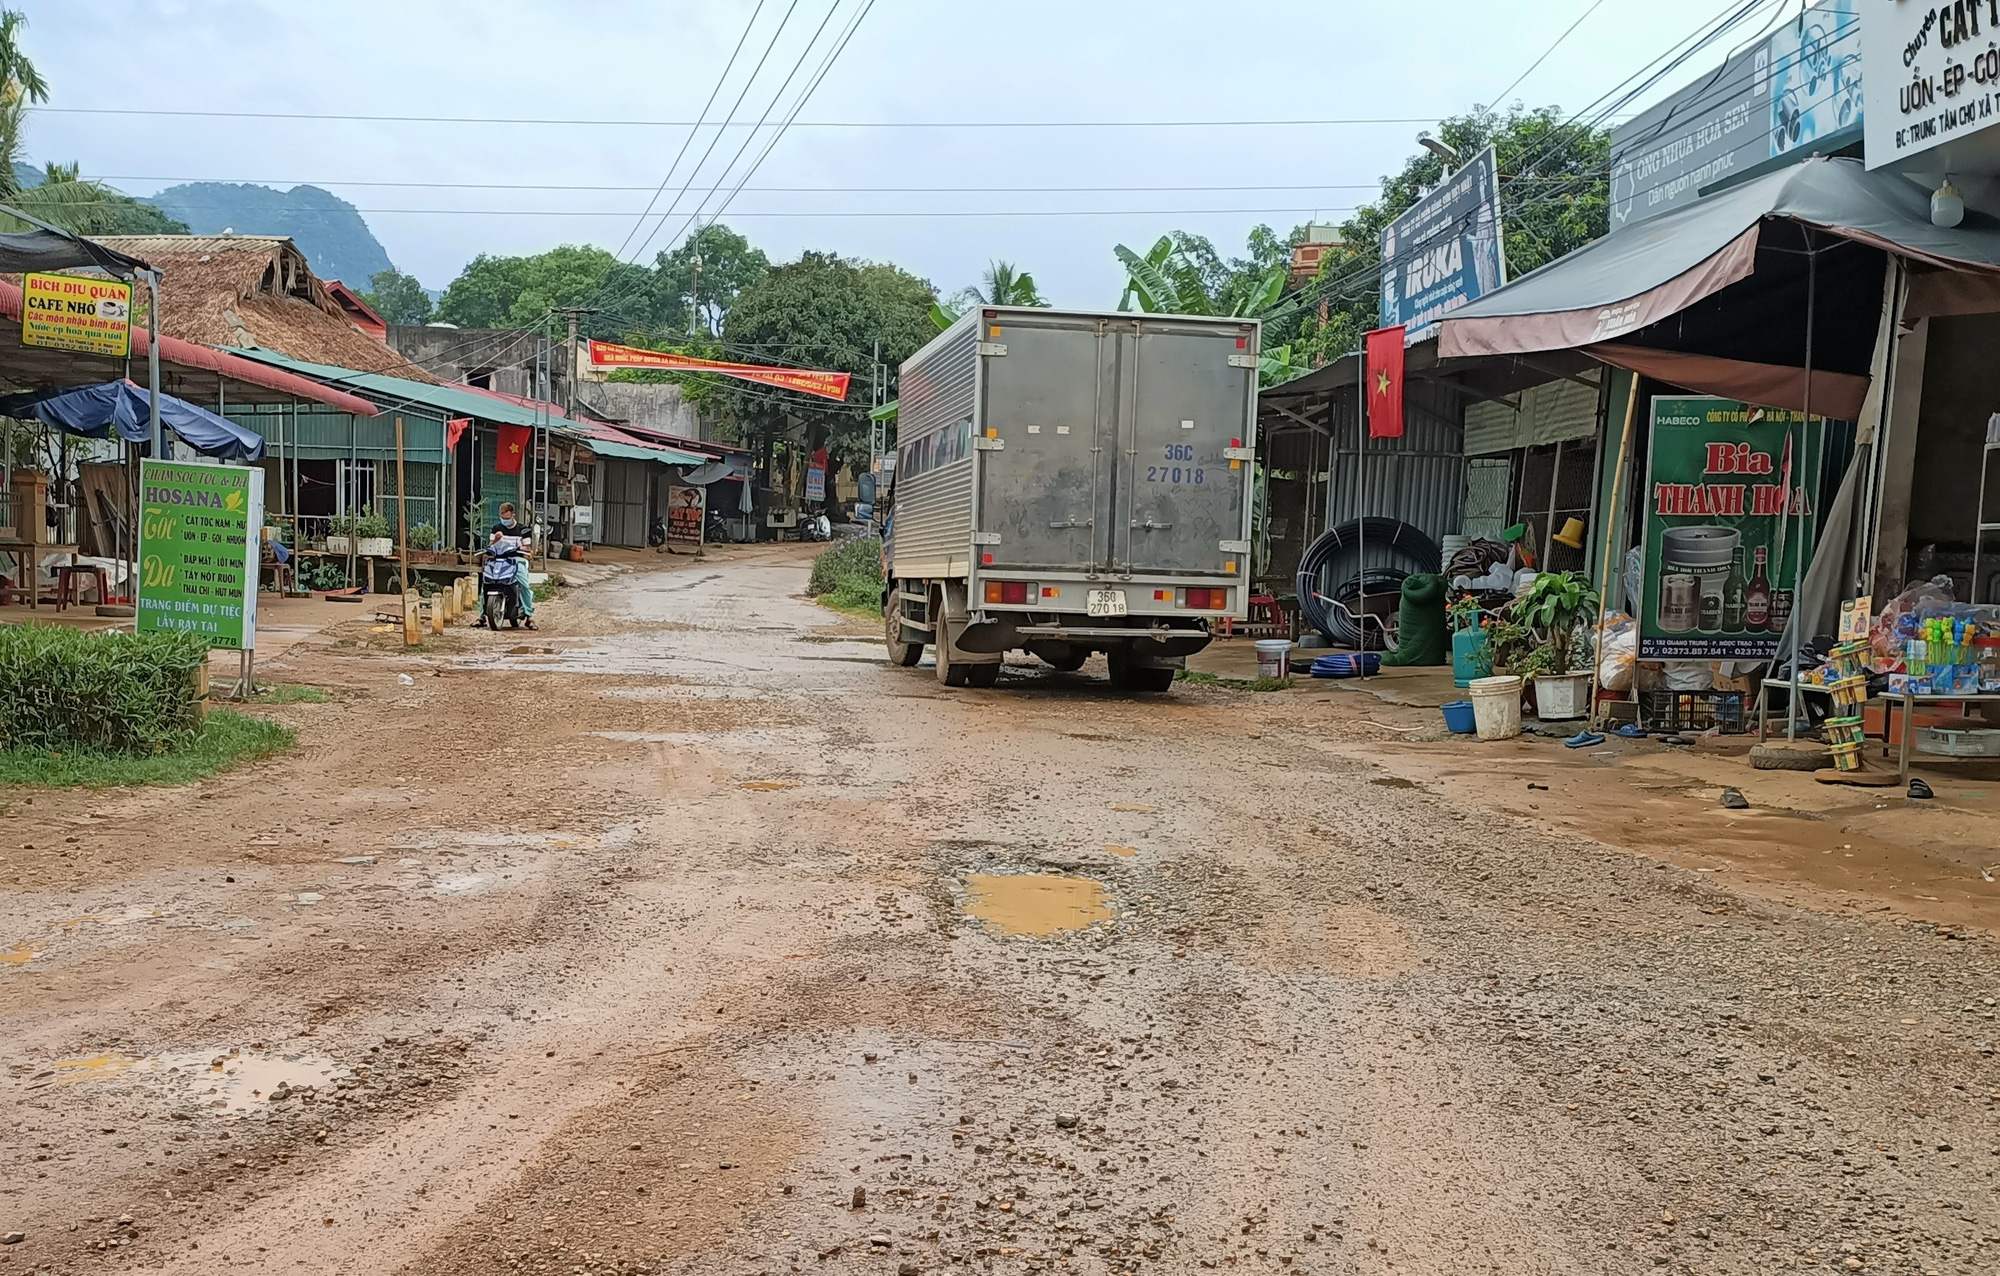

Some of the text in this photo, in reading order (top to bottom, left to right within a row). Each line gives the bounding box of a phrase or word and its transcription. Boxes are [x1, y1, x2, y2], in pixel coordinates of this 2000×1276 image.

[1903, 8, 1937, 68] Chuyên
[1939, 108, 1957, 133] TÂM
[1959, 99, 1976, 126] CHỢ
[1978, 93, 1992, 119] XÃ
[1636, 148, 1660, 180] ỐNG
[1696, 120, 1722, 151] HOA
[1724, 101, 1751, 135] SEN
[1405, 237, 1463, 299] IRUKA
[30, 277, 127, 300] BÍCH DỊU QUÁN
[28, 297, 63, 312] CAFE
[28, 311, 43, 320] Các
[46, 313, 64, 323] môn
[66, 316, 87, 328] nhậu
[110, 321, 127, 331] dân
[66, 326, 82, 335] hoa
[1657, 416, 1700, 426] HABECO
[1706, 408, 1722, 422] CÔNG
[1722, 411, 1730, 422] TY
[1766, 408, 1775, 422] HÀ
[1164, 444, 1193, 461] 36C
[1703, 442, 1773, 475] Bia
[176, 468, 197, 484] SÓC
[199, 470, 218, 485] TÓC
[1147, 466, 1204, 484] 27018
[145, 486, 223, 508] HOSANA
[1654, 482, 1747, 516] THANH
[144, 507, 177, 540] Tóc
[215, 519, 230, 528] NAM
[143, 554, 176, 588] Da
[140, 597, 241, 619] TRANG ĐIỂM DỰ TIỆC
[156, 612, 218, 632] LẤY RÁY TAI
